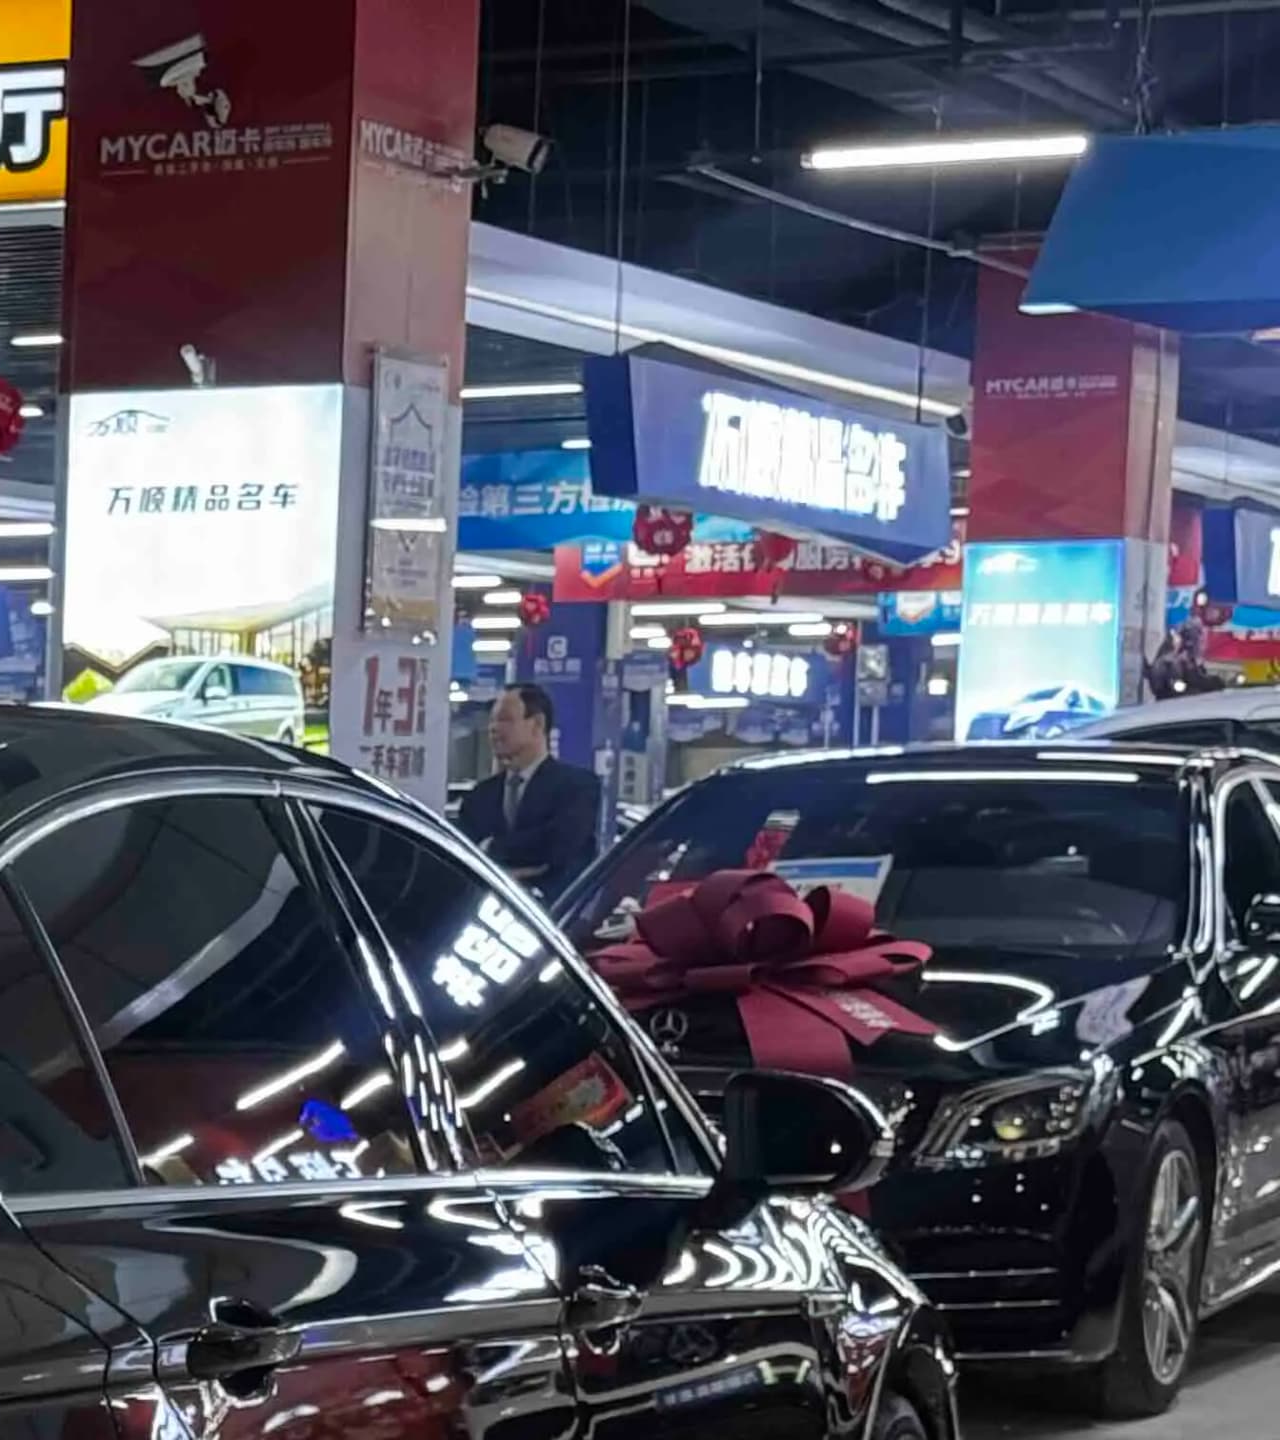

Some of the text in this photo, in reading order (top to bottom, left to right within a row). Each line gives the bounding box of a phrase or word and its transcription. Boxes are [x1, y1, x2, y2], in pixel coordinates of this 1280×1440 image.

[107, 482, 300, 516] 万顺精品名车
